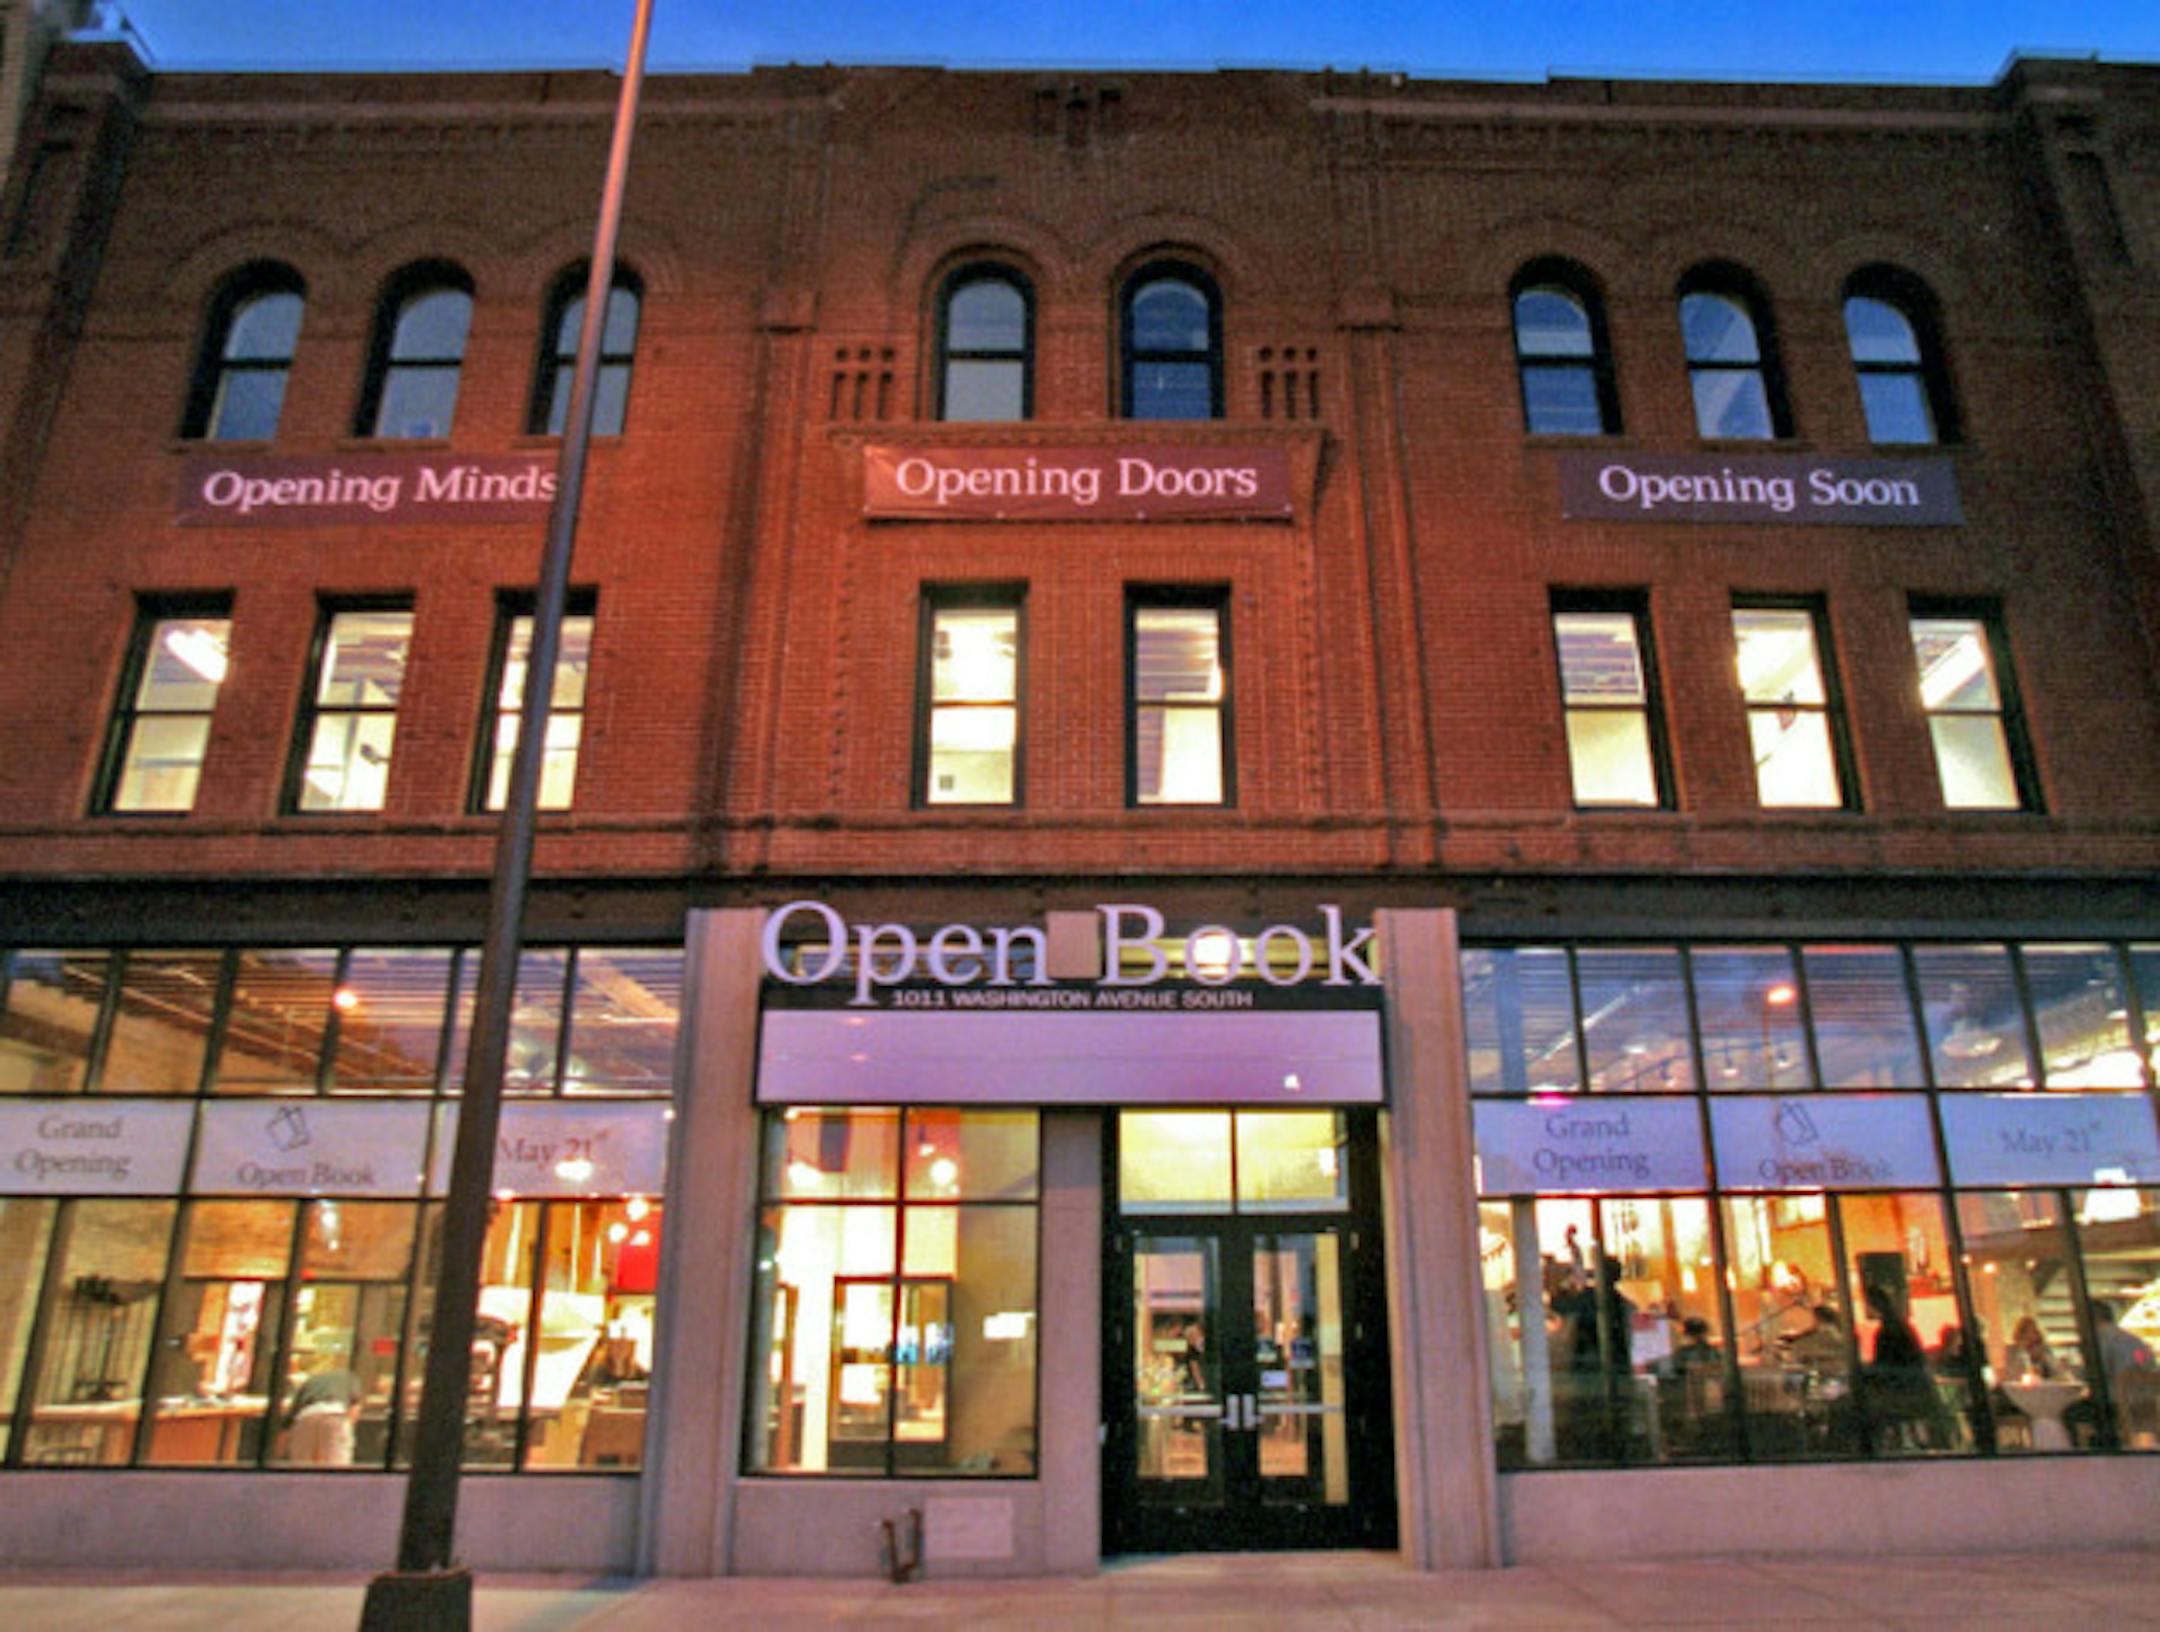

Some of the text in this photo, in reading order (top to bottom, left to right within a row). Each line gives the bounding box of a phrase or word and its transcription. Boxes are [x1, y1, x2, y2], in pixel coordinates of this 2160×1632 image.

[202, 466, 558, 512] Opening Minds
[896, 457, 1259, 505] Opening Doors
[1599, 464, 1921, 512] Opening Soon
[761, 900, 1384, 1006] Open Book
[893, 989, 1254, 1009] 1011 WASHINGTON AVENUE SOUTH
[37, 1114, 123, 1140] Grand
[1545, 1112, 1630, 1140] Grand
[14, 1149, 132, 1180] Opening
[1532, 1149, 1650, 1180] Opening
